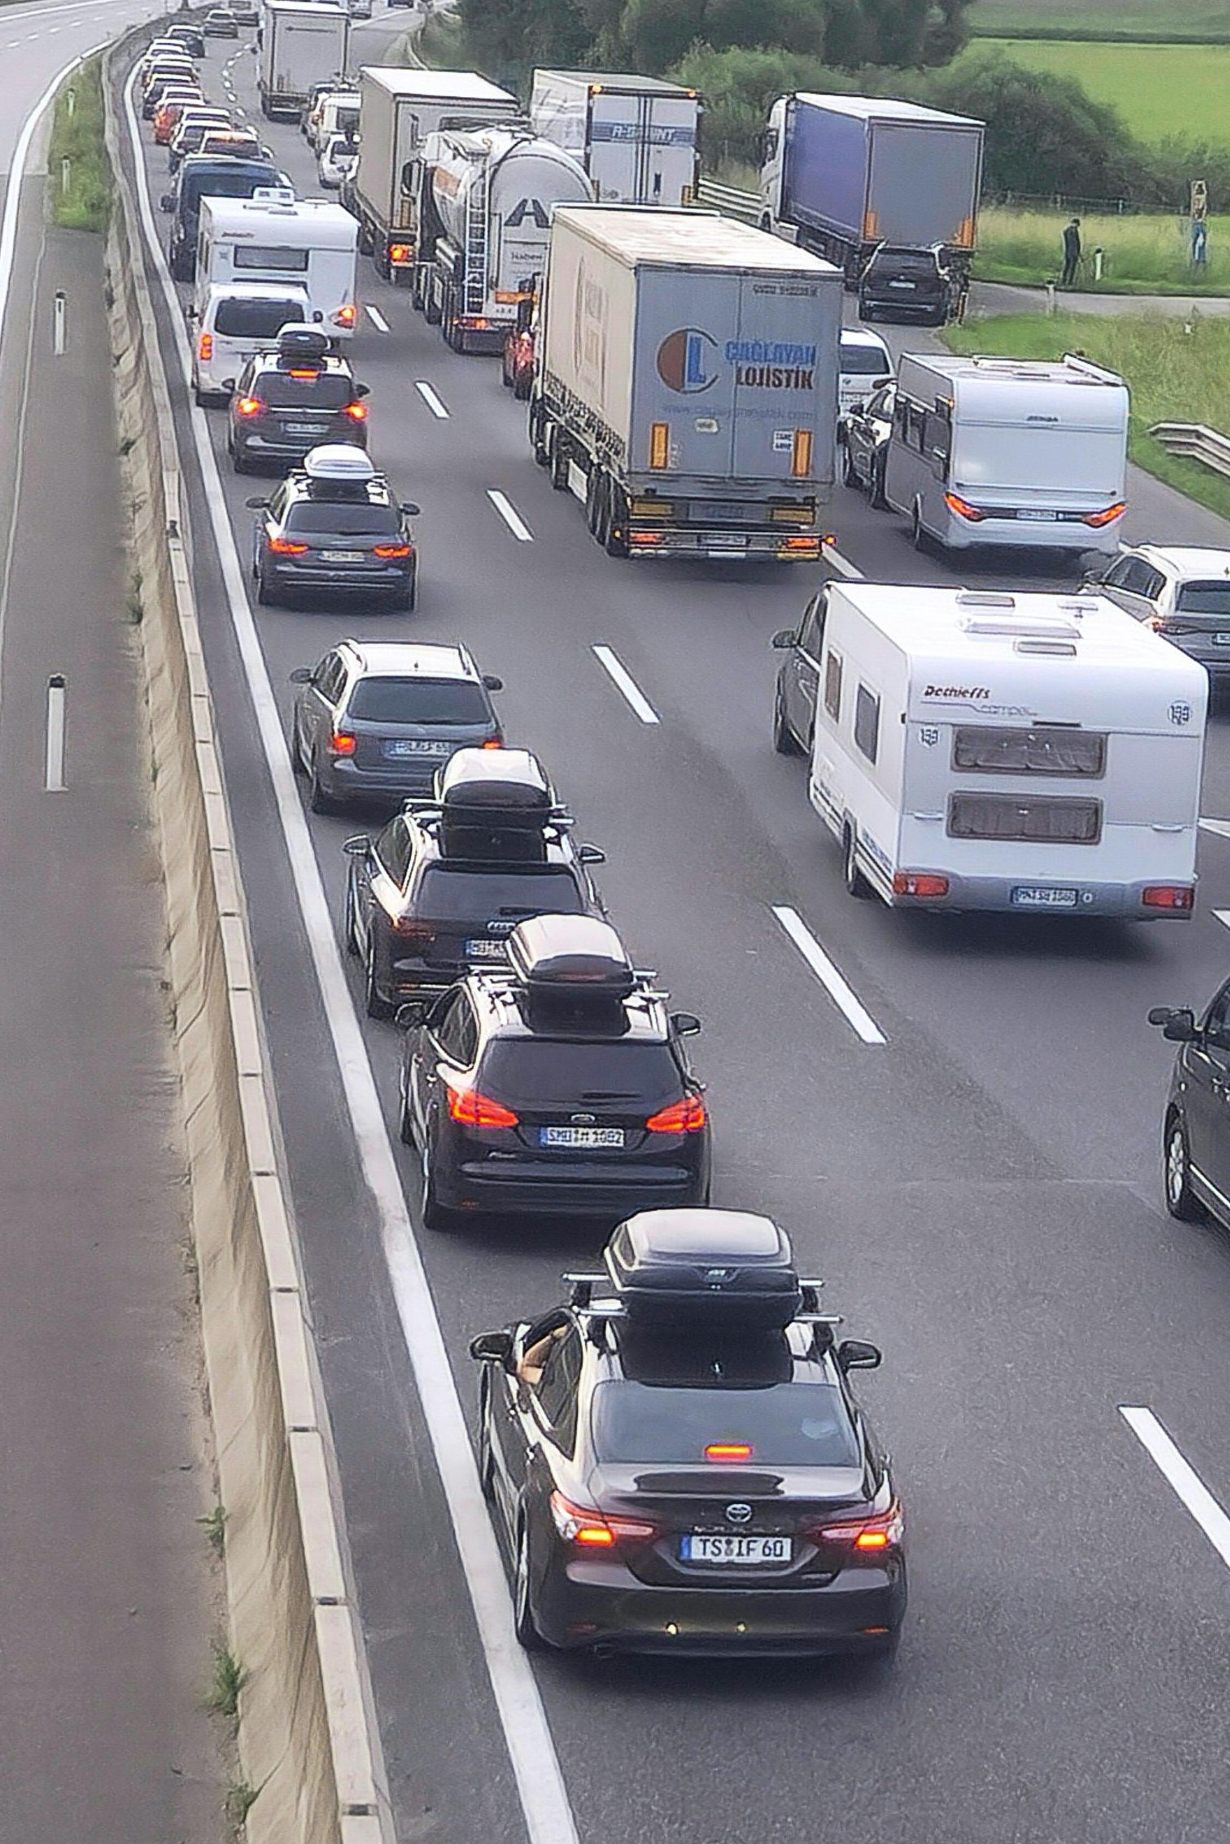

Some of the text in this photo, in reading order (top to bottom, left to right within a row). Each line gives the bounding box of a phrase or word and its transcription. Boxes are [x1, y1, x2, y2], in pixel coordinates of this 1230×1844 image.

[699, 1538, 784, 1558] TS IF 60
